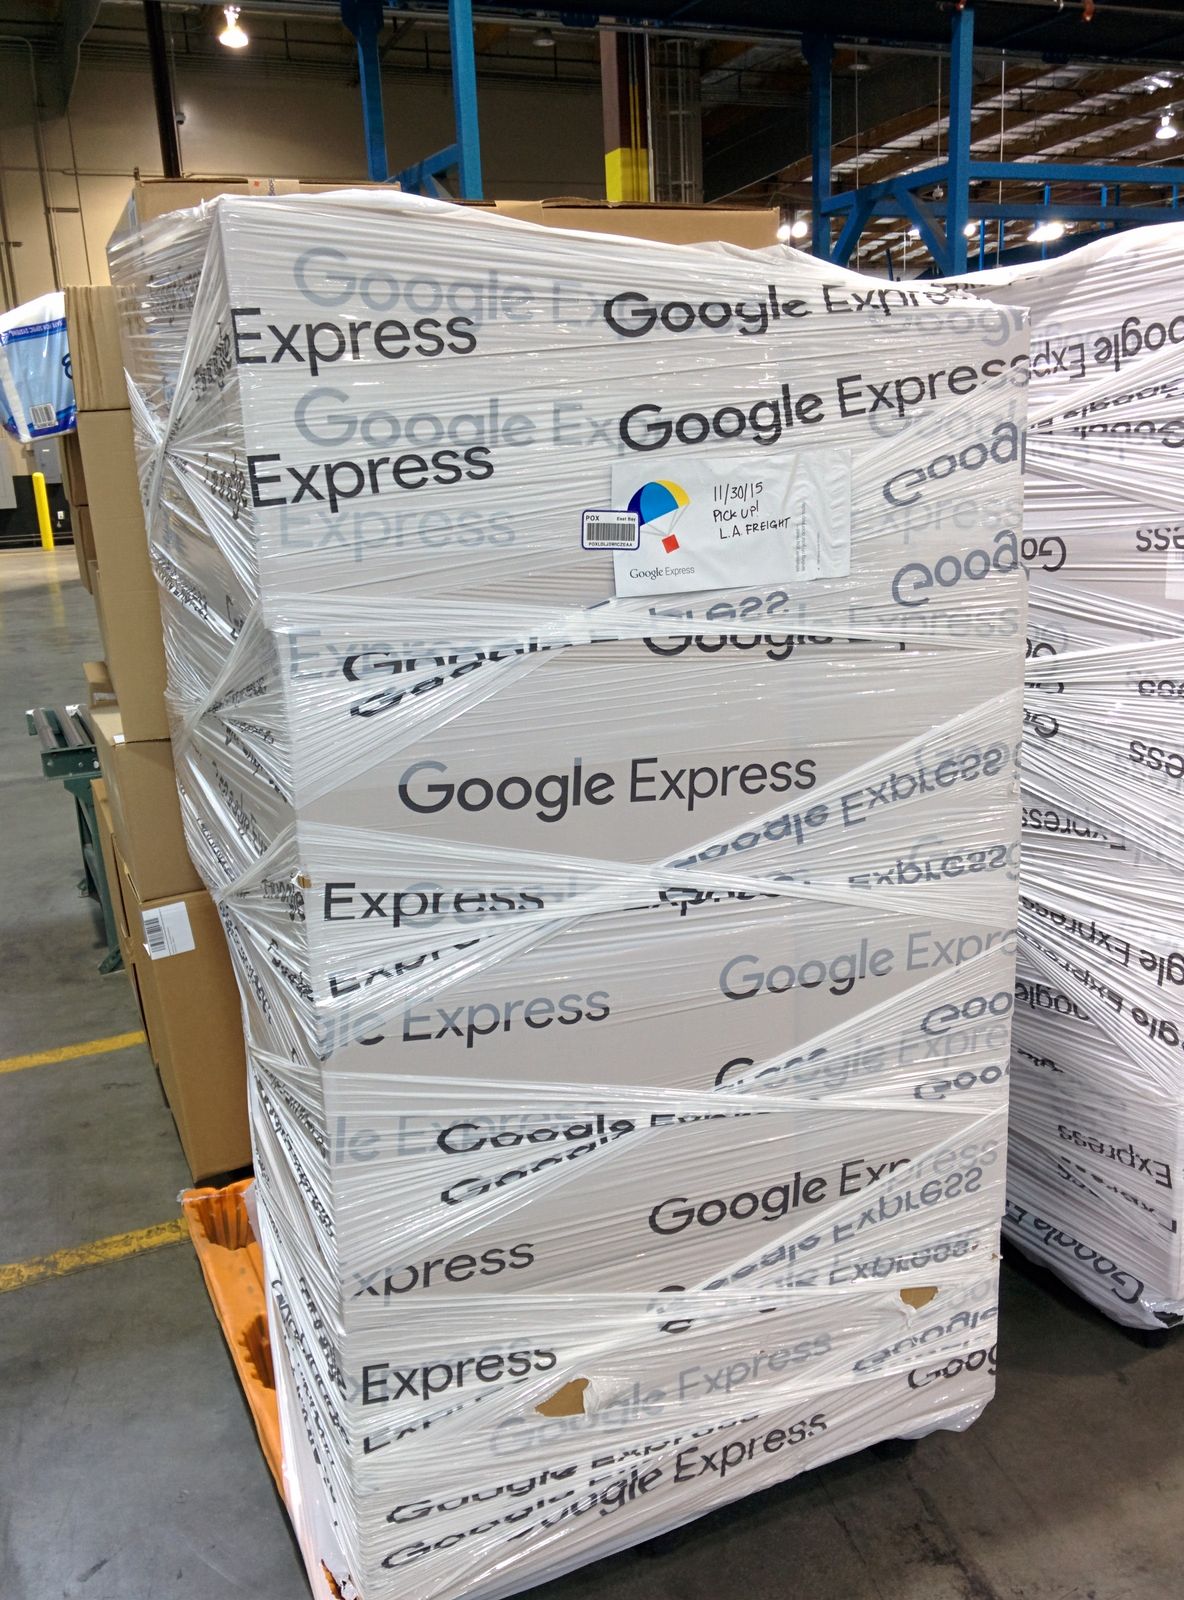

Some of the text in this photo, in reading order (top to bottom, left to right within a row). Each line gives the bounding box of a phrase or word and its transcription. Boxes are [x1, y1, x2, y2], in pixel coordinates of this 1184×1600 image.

[604, 285, 812, 337] Google
[231, 308, 477, 376] Express
[619, 384, 825, 451] Google
[247, 444, 494, 513] Express
[713, 481, 763, 505] 11/30/15
[741, 500, 759, 519] UP!
[745, 516, 791, 535] FREIGHT
[629, 566, 696, 580] Google Express
[398, 756, 817, 822] Google Express
[719, 938, 895, 1000] Google
[402, 990, 610, 1048] Express
[649, 1171, 827, 1235] Google
[362, 1348, 557, 1406] Express
[673, 1413, 828, 1484] Express
